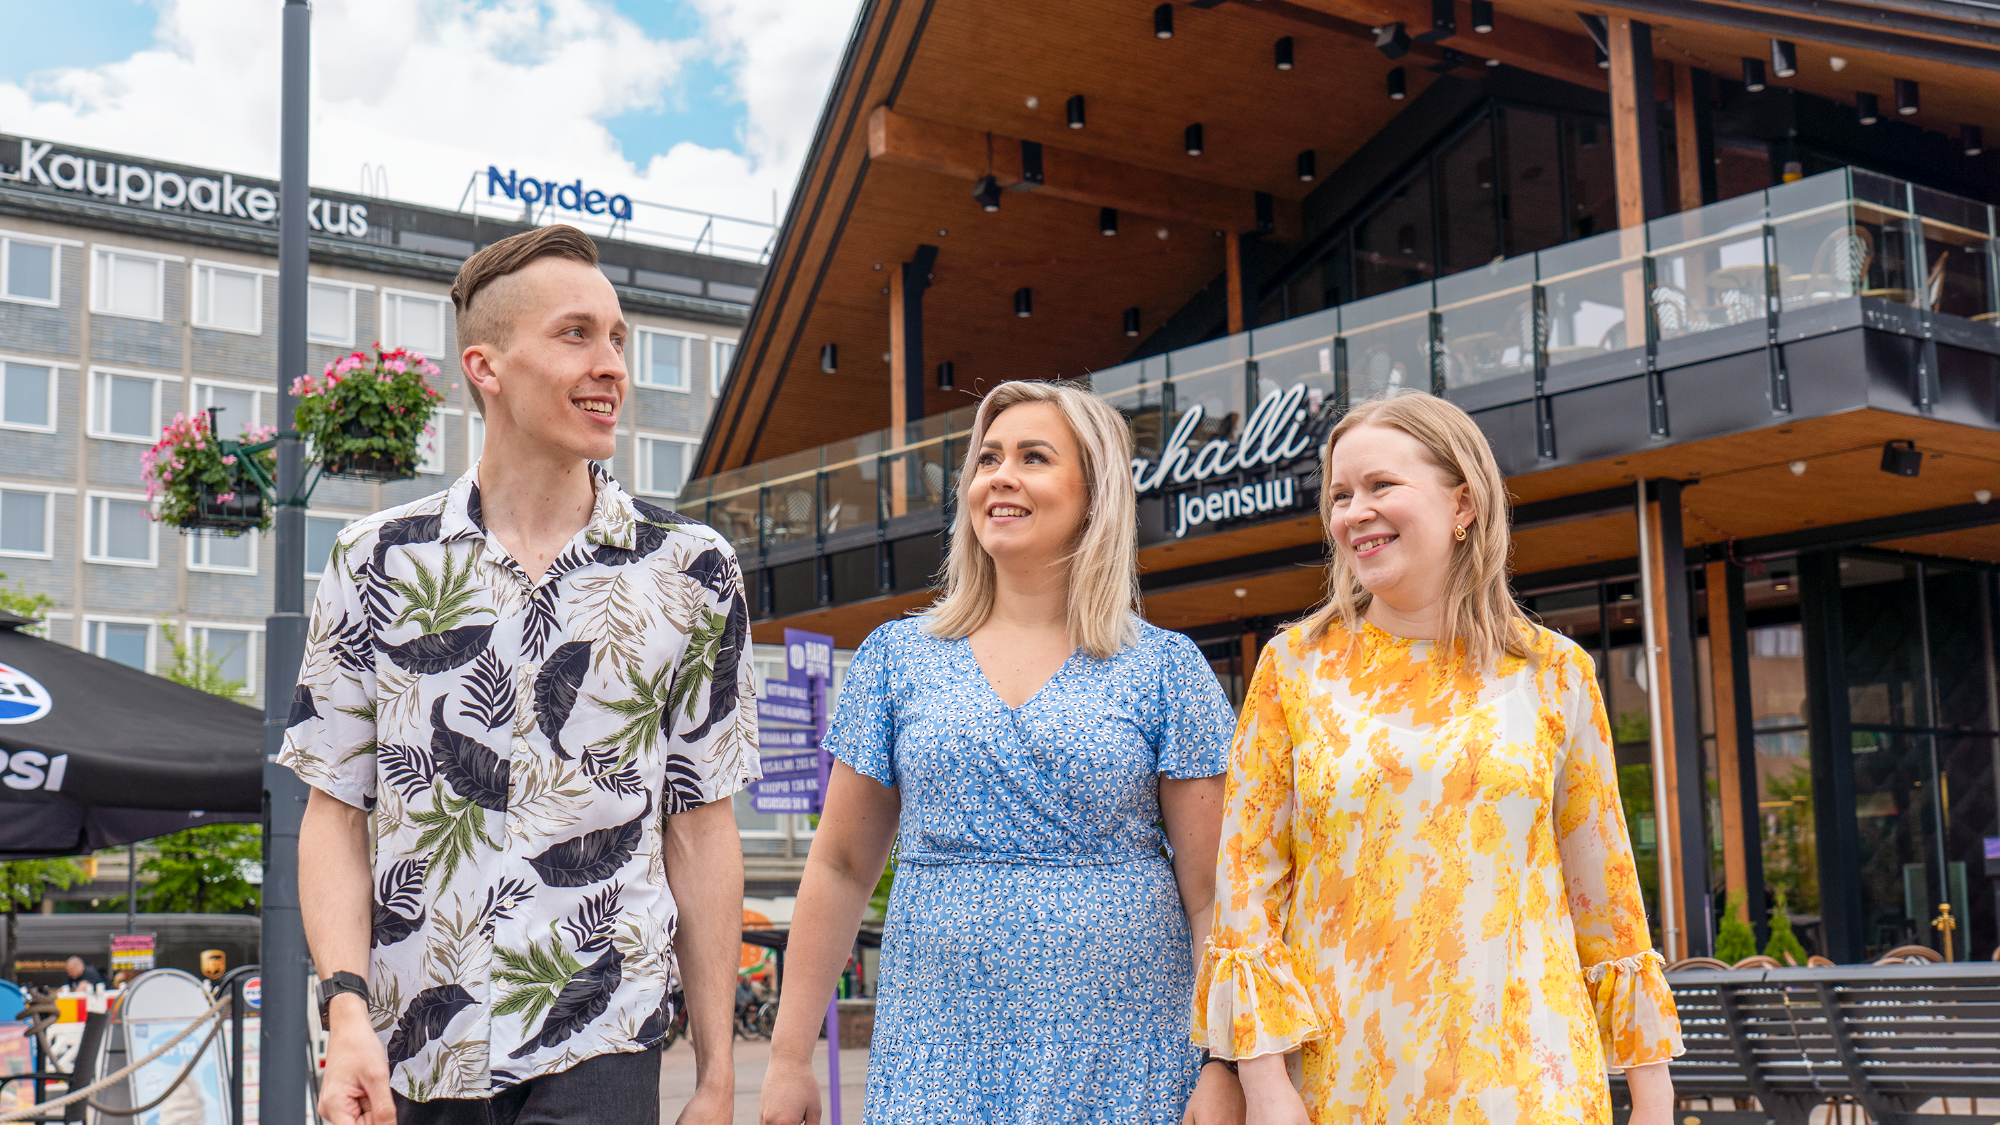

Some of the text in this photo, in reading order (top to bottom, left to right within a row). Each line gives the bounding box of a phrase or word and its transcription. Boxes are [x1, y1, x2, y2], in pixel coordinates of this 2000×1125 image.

[20, 138, 369, 239] Kauppakeus
[488, 165, 632, 221] Nordea
[1175, 476, 1293, 538] Joensuu
[0, 748, 69, 792] SI
[758, 780, 790, 793] KUOPIO
